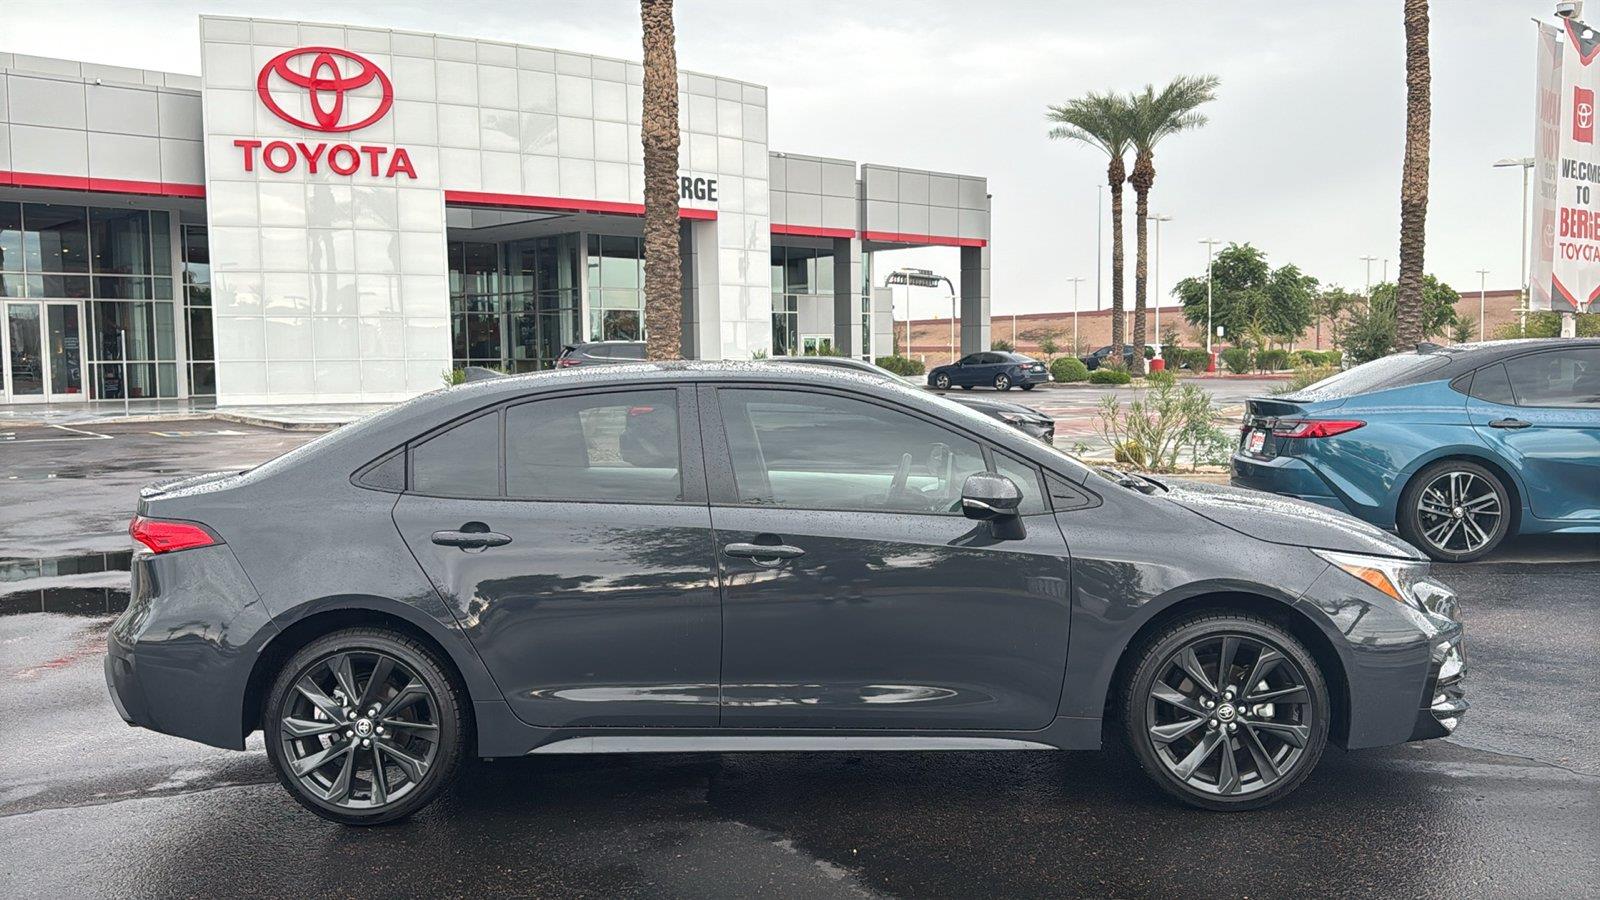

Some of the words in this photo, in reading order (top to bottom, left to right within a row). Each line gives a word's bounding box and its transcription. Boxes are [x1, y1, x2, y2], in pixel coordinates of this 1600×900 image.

[234, 139, 417, 179] TOYOTA
[681, 176, 718, 202] RGE
[1576, 185, 1590, 205] TO
[1559, 242, 1600, 262] TOYOTA
